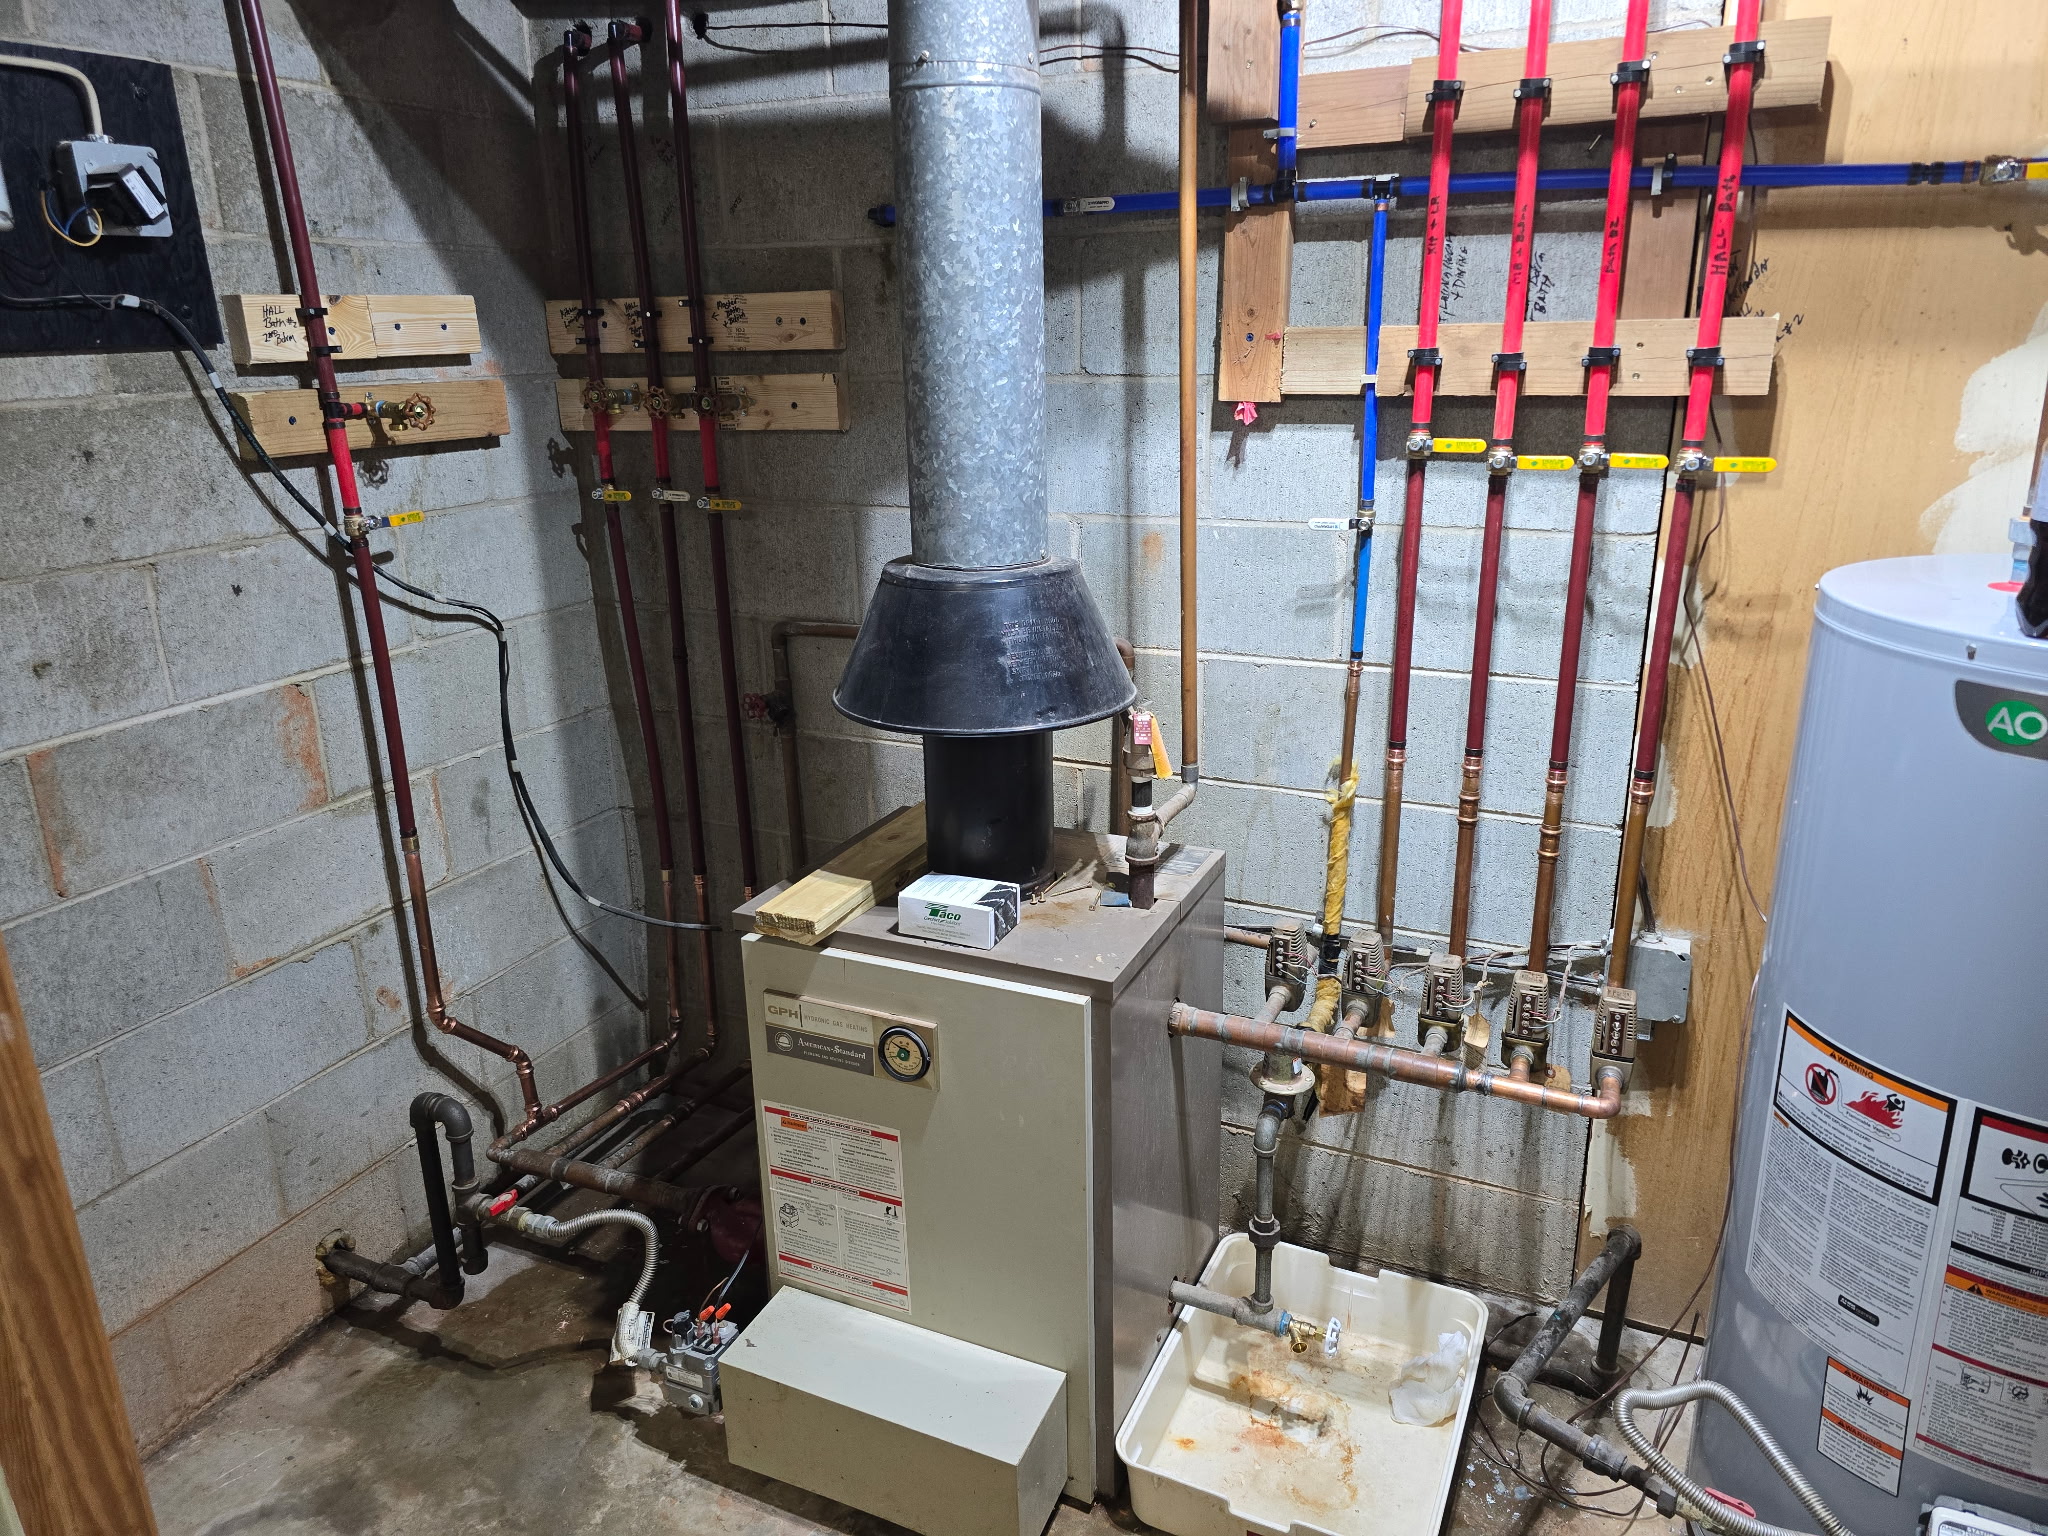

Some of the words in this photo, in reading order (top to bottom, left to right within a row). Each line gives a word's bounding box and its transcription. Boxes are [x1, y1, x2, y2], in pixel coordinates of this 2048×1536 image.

[1718, 174, 1736, 212] Bath
[1710, 228, 1728, 275] HALL
[262, 304, 285, 318] HALL
[263, 316, 287, 328] Bath
[1988, 706, 2048, 740] AO
[924, 902, 962, 921] Taco
[767, 1005, 798, 1019] GPH
[804, 1014, 830, 1025] HYDRONIC
[846, 1023, 868, 1033] HEATING
[1837, 1056, 1874, 1080] WARNING
[1986, 1288, 2016, 1302] WARNING
[1850, 1372, 1889, 1397] WARNING
[1845, 1424, 1882, 1448] WARNING
